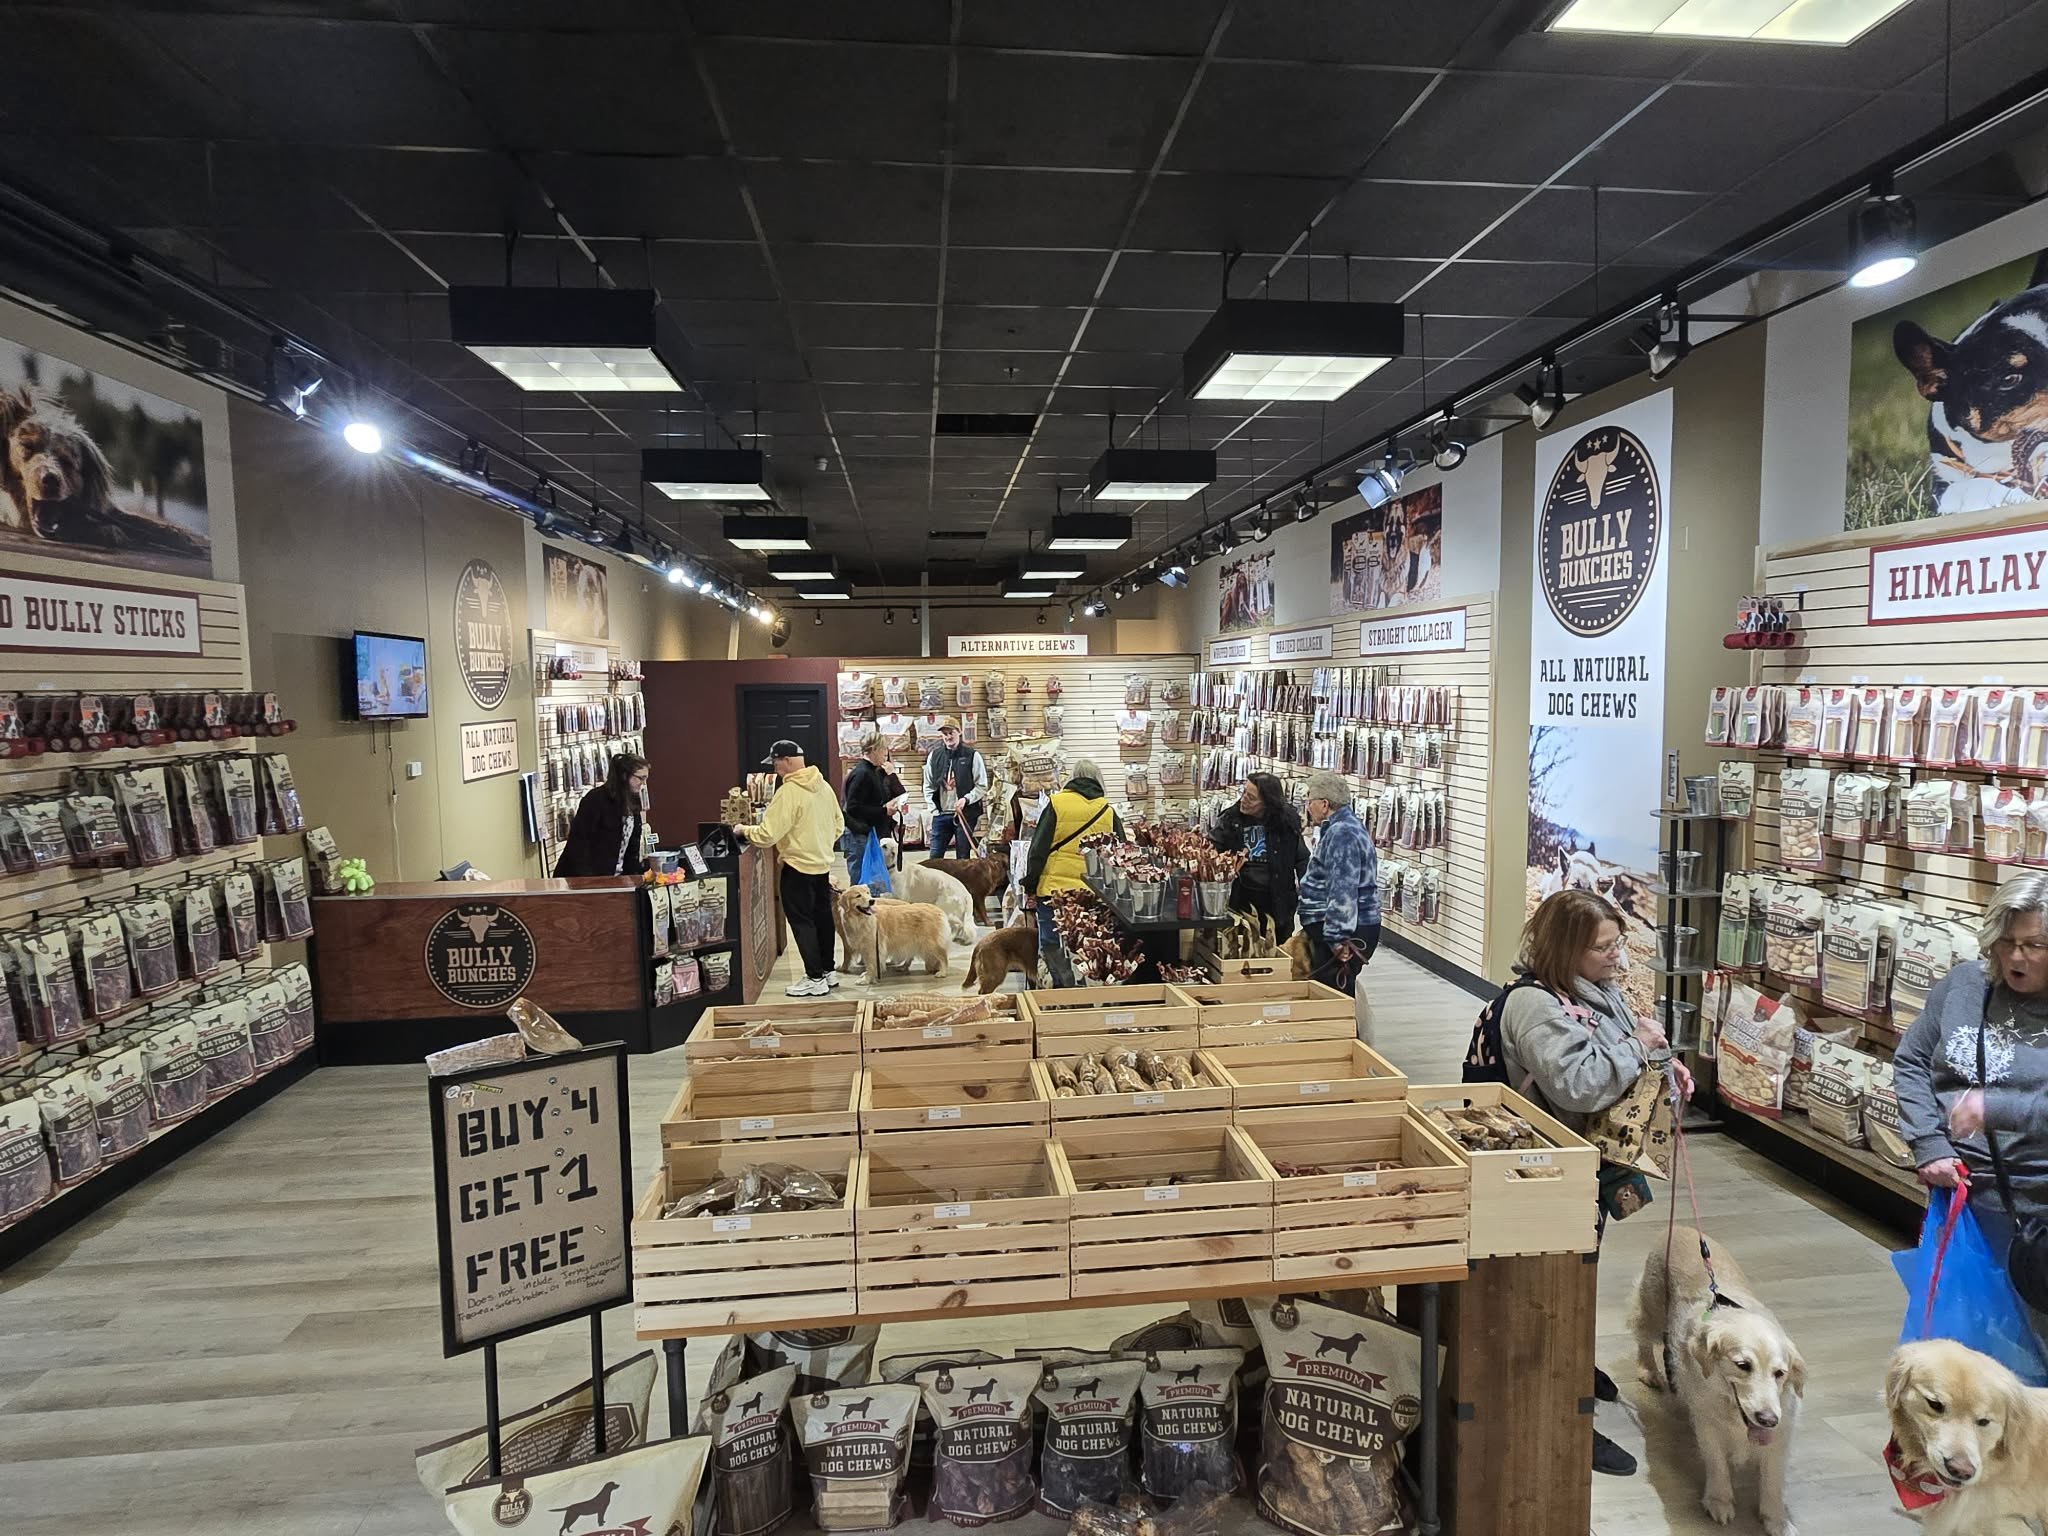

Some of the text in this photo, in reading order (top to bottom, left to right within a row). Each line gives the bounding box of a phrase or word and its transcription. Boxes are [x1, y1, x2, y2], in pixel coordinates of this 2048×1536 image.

[1560, 508, 1632, 560] BULLY
[1558, 550, 1632, 589] BUNCHES
[1888, 550, 2048, 602] HIMALAY
[24, 596, 103, 633] BULLY
[113, 604, 186, 638] STICKS
[468, 622, 502, 650] BULLY
[1368, 621, 1453, 646] STRAIGHT COLLAGEN
[960, 640, 1076, 652] ALTERNATIVE CHEWS
[469, 651, 505, 672] BUNCHES
[1540, 655, 1649, 683] ALL NATURAL
[1547, 692, 1637, 719] DOG CHEWS
[465, 726, 515, 749] ALL NATURAL
[472, 750, 512, 773] DOG CHEWS
[446, 946, 513, 968] BULLY
[447, 966, 517, 984] BUNCHES
[1813, 1074, 1848, 1095] NATURAL
[457, 1086, 599, 1158] BUY 4
[0, 1139, 38, 1160] ATURAL
[459, 1153, 598, 1223] GET 1
[466, 1226, 585, 1294] FREE
[467, 1292, 494, 1308] Does
[497, 1286, 516, 1298] not
[1305, 1363, 1366, 1388] PREMIUM
[1170, 1386, 1209, 1397] PREMIUM
[962, 1405, 1001, 1418] PREMIUM
[1068, 1402, 1108, 1414] PREMIUM
[1161, 1406, 1220, 1420] NATURAL
[1284, 1387, 1379, 1427] NATURAL
[737, 1415, 770, 1432] PREMIUM
[836, 1422, 877, 1435] PREMIUM
[953, 1424, 1013, 1442] NATURAL
[1060, 1421, 1119, 1437] NATURAL
[1157, 1420, 1224, 1436] DOG CHEWS
[1055, 1435, 1121, 1451] DOG CHEWS
[1316, 1418, 1384, 1451] CHEWS
[729, 1442, 779, 1468] DOG CHEW
[826, 1442, 887, 1458] NATURAL
[948, 1438, 1017, 1457] DOG CHEWS
[820, 1458, 892, 1473] DOG CHEWS
[500, 1500, 524, 1513] BULLY
